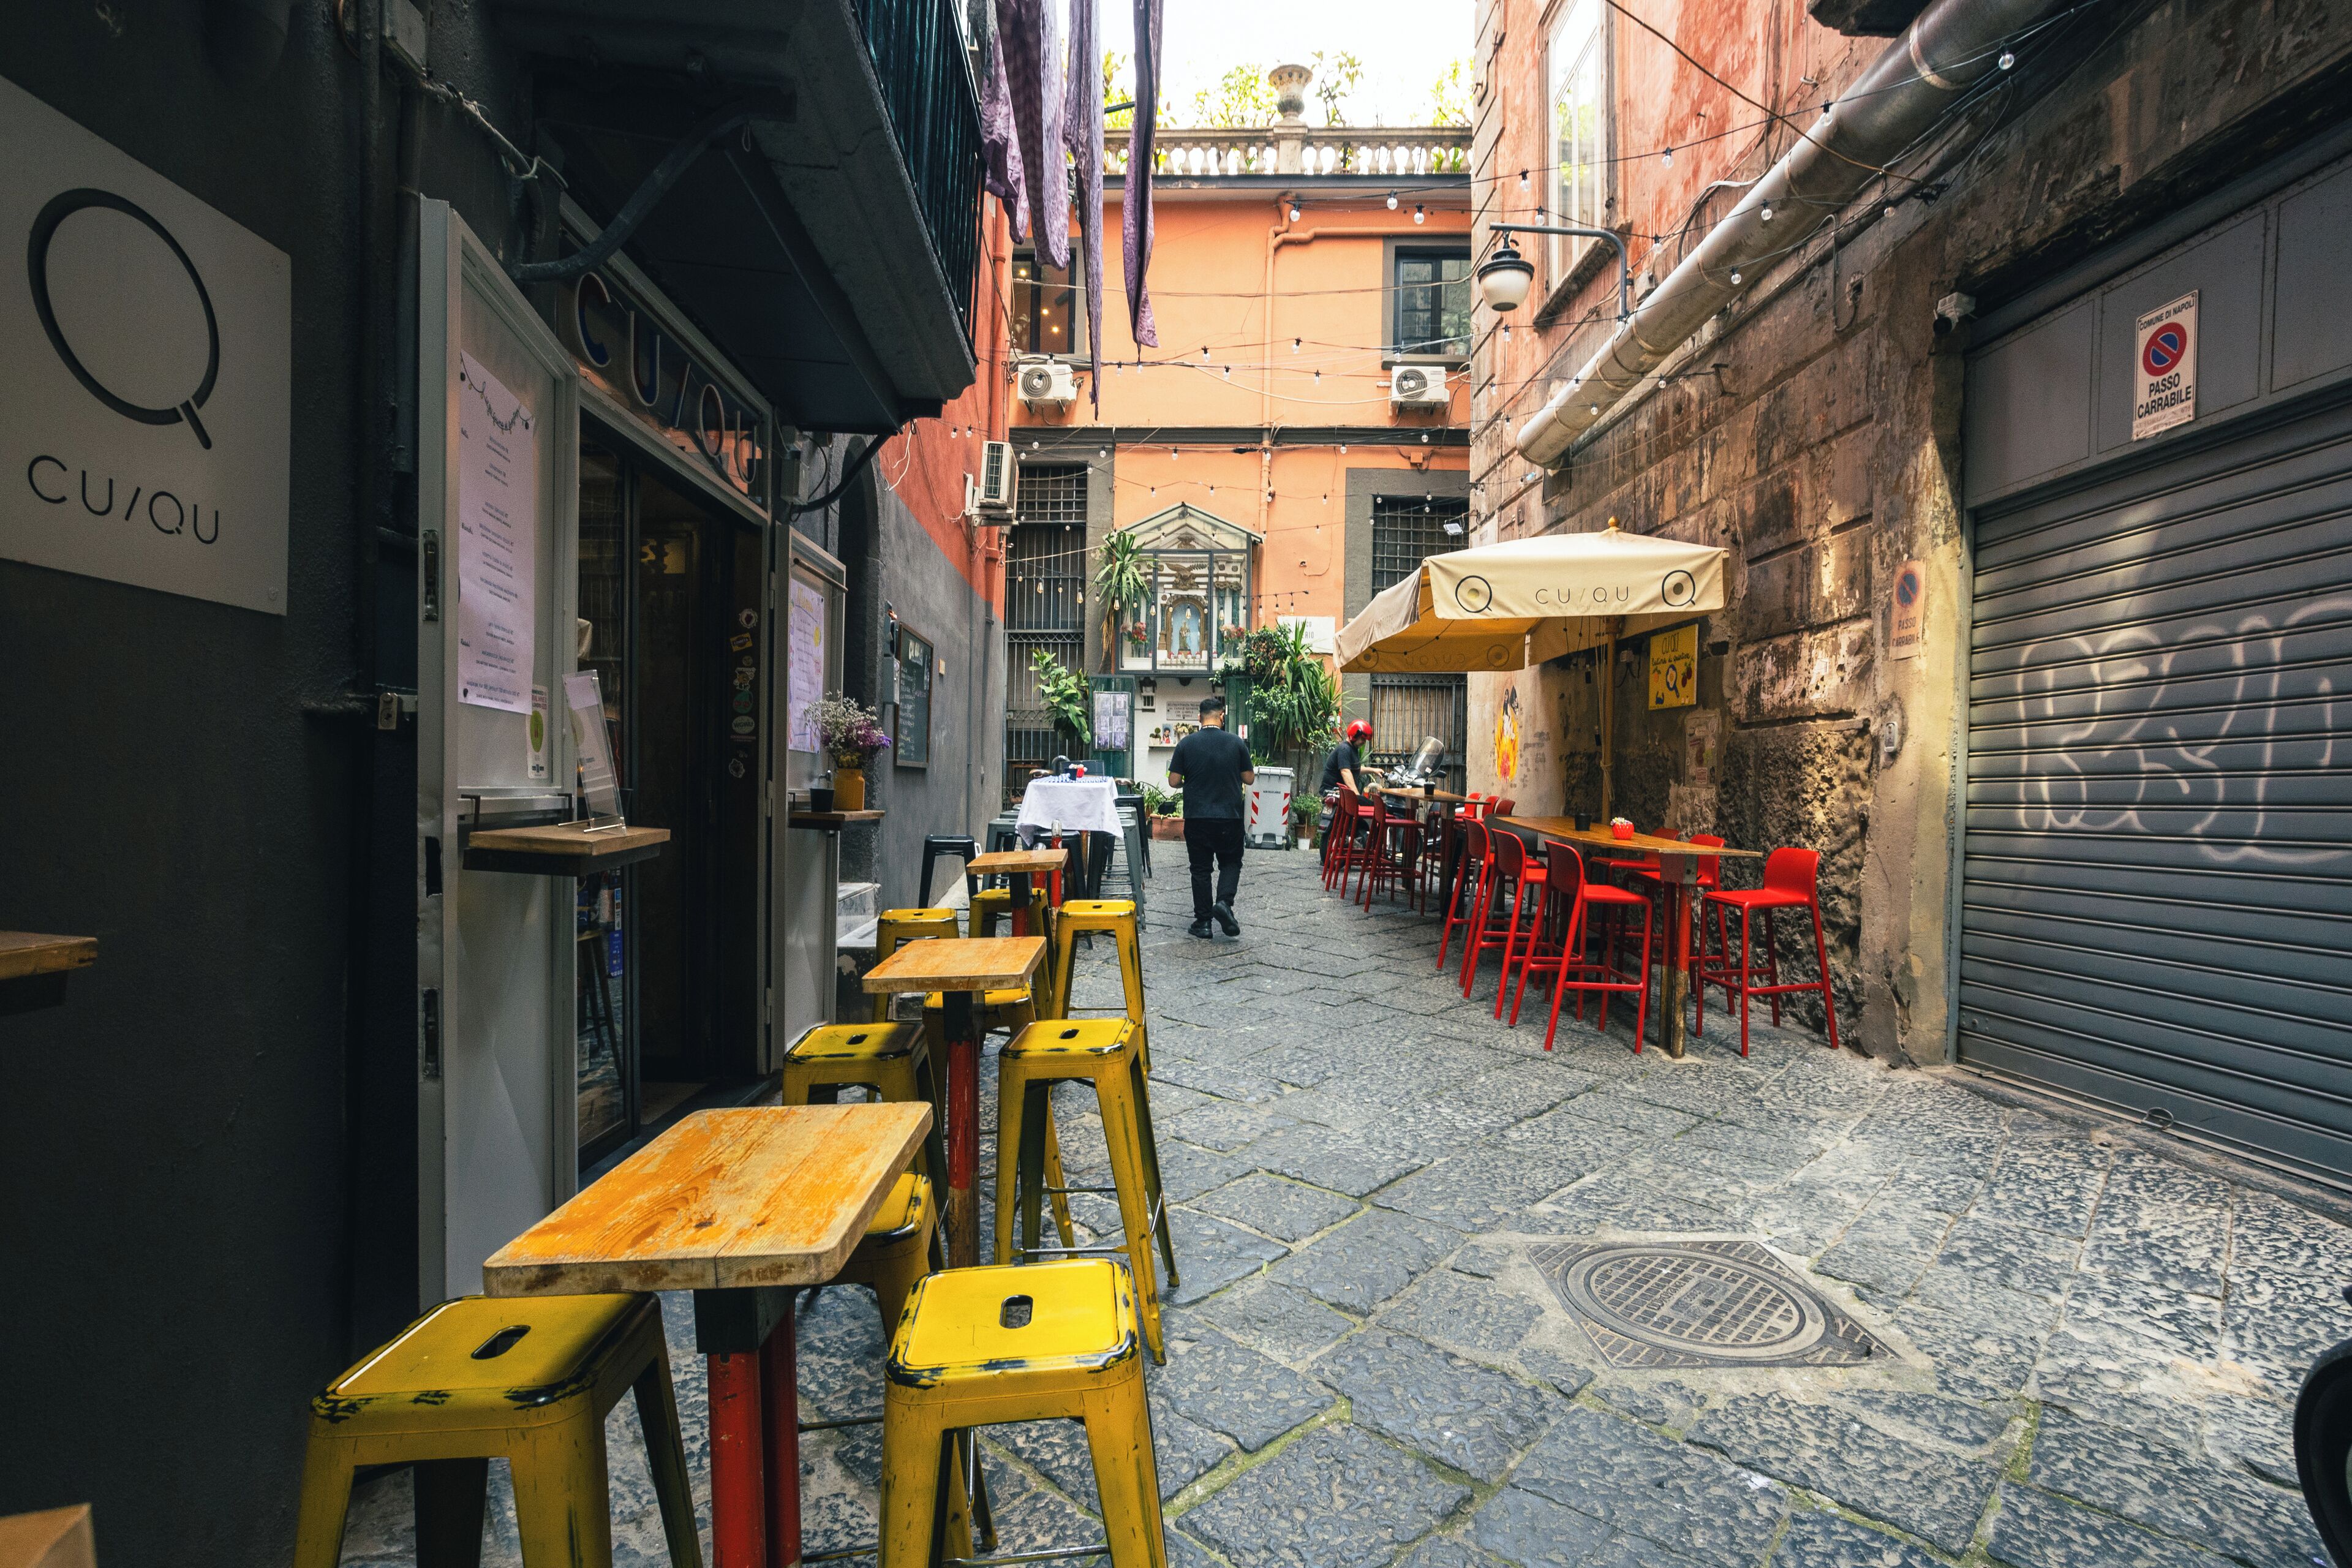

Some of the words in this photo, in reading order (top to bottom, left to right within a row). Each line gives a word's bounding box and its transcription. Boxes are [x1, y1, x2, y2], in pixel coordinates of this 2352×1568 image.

[2139, 314, 2163, 331] COMUNE
[2173, 299, 2195, 315] NAPOLI
[2149, 372, 2180, 398] PASSO
[2138, 385, 2192, 418] CARRABILE
[28, 456, 218, 544] CU/QU
[1898, 616, 1917, 631] PASSO
